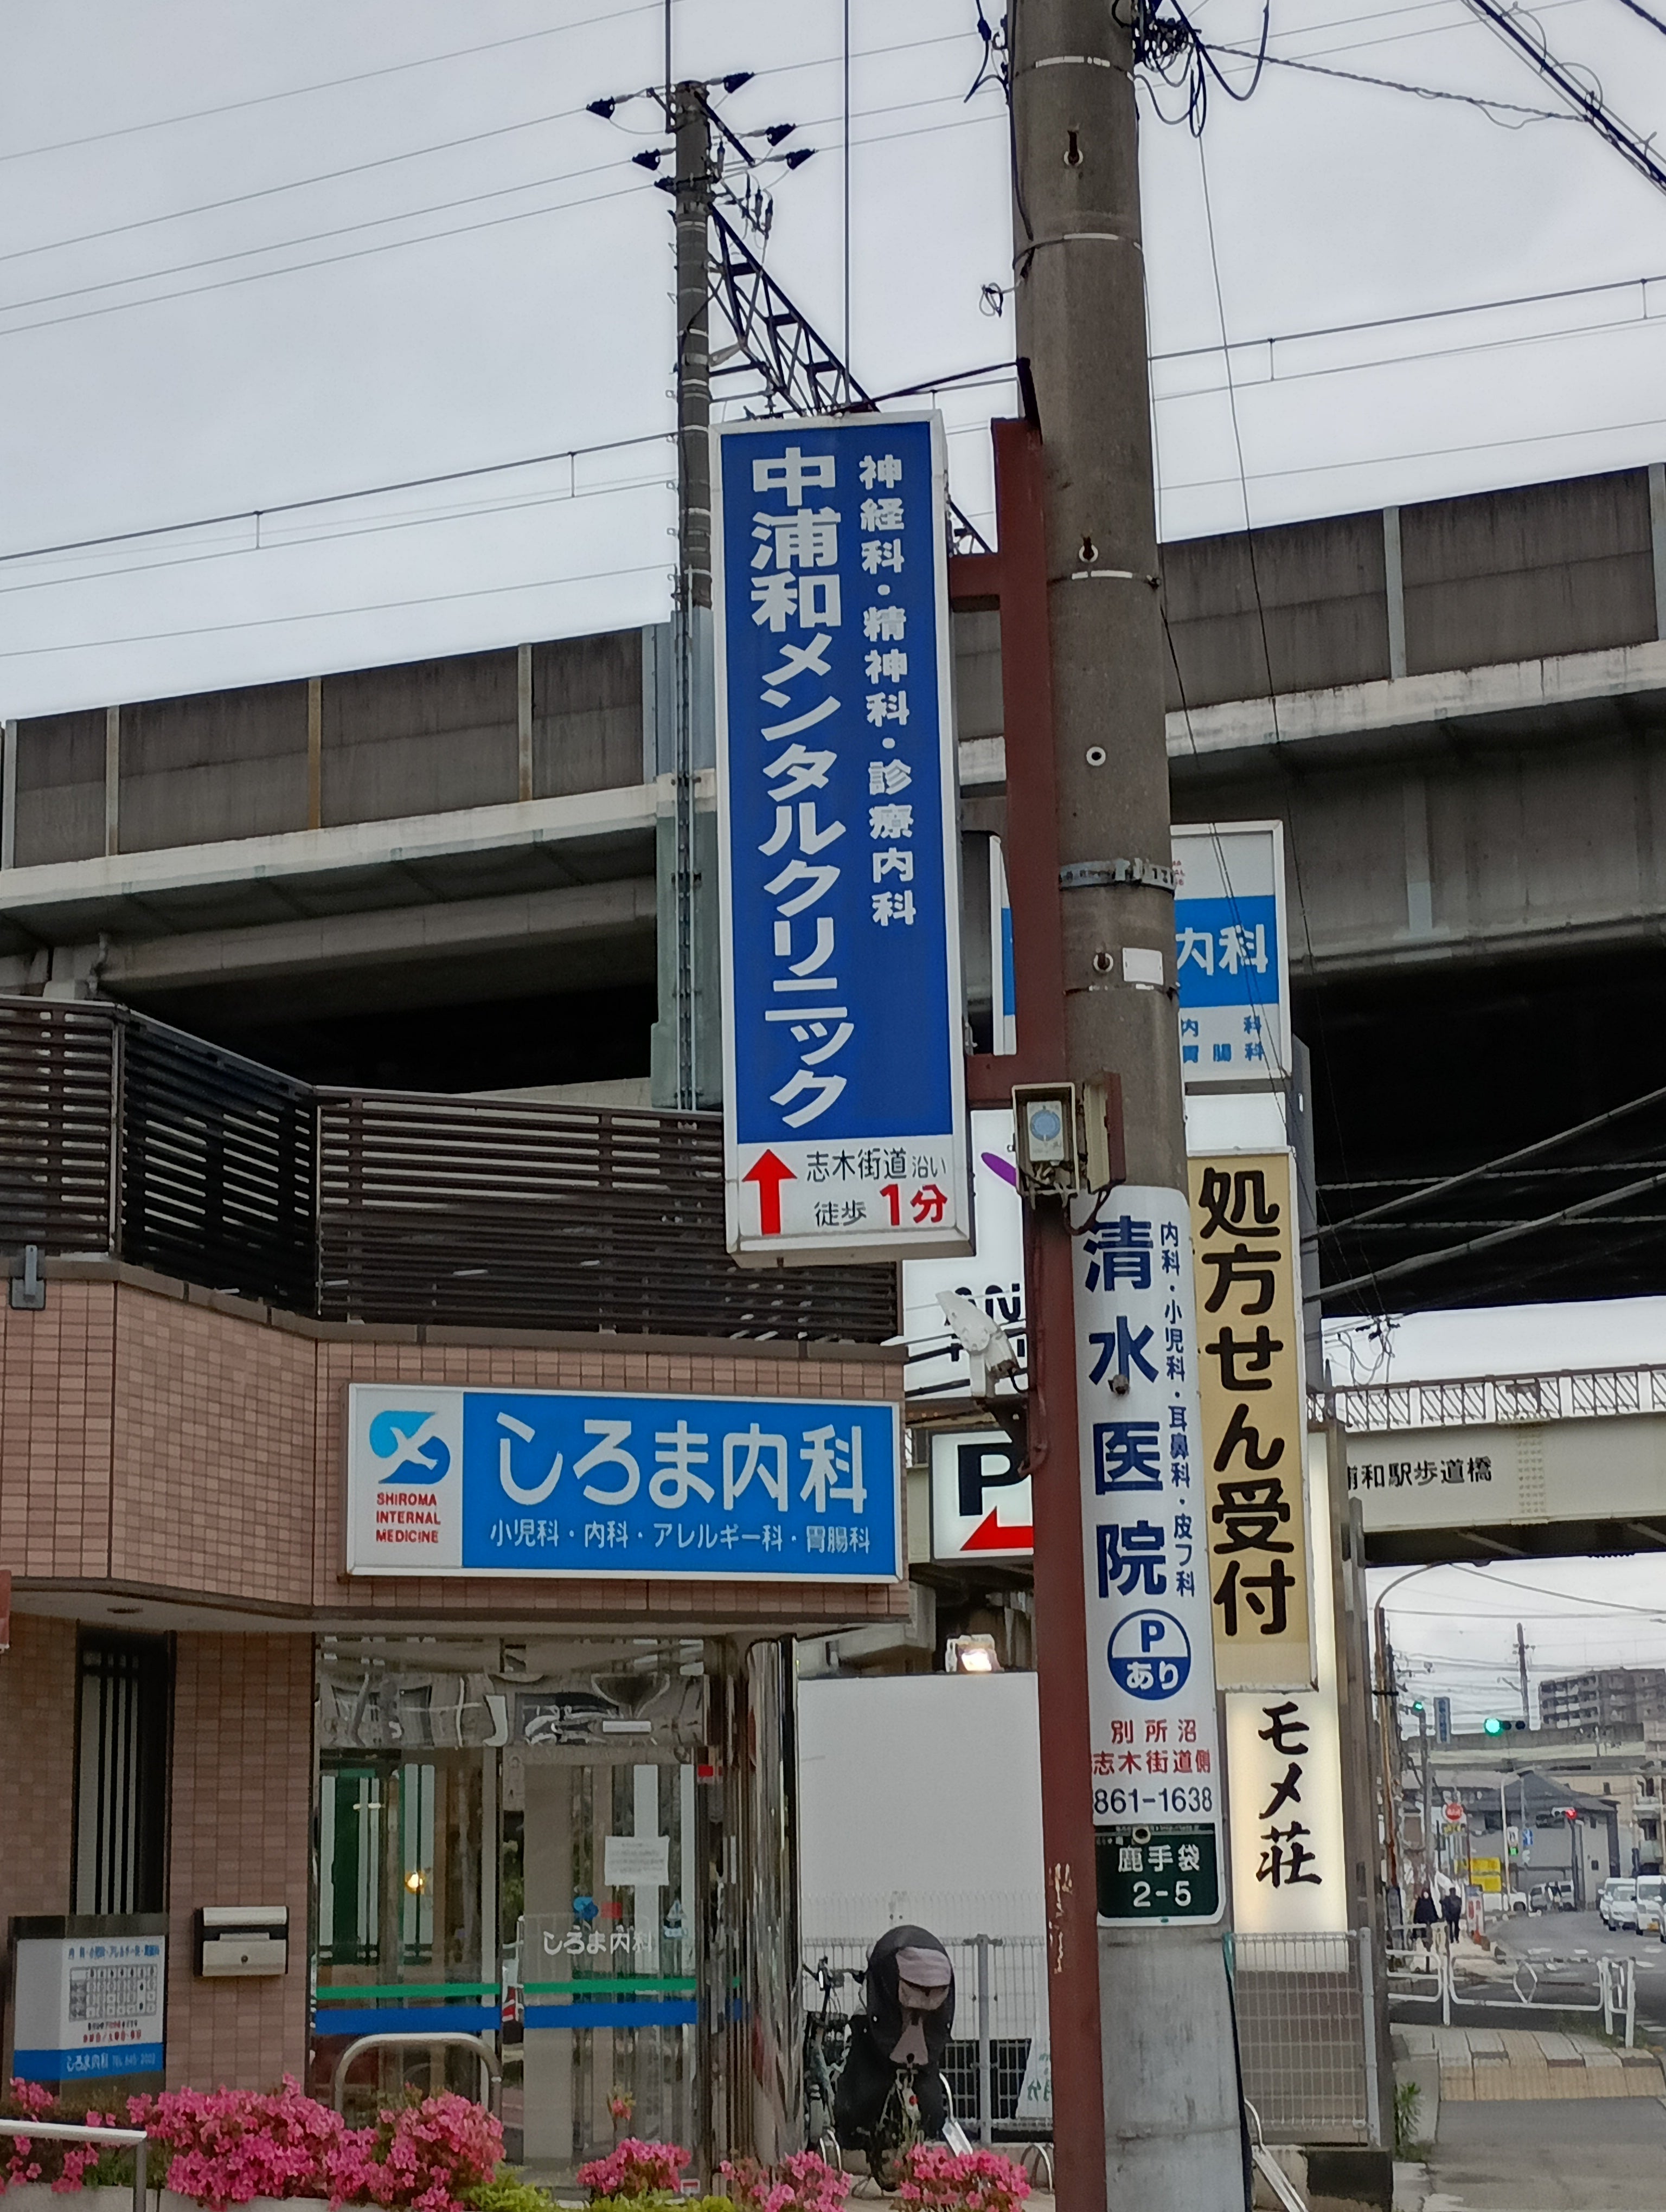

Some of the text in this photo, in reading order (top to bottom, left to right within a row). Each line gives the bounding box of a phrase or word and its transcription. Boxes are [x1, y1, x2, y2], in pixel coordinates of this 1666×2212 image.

[859, 454, 916, 927] 神経科・精神科・診療内科
[751, 447, 854, 1129] 中浦和メンタルクリニック
[806, 1147, 947, 1182] 志木街道沿い
[1085, 1214, 1167, 1599] 清水医院
[1199, 1167, 1295, 1636] 処方せん受付
[496, 1411, 868, 1515] しろま内科
[377, 1492, 437, 1506] SHIROMA
[376, 1510, 441, 1525] INTERNAL
[376, 1529, 438, 1543] MEDICINE
[1139, 1619, 1165, 1652] P
[1126, 1661, 1180, 1690] あり
[1111, 1719, 1197, 1744] 別所沼
[1093, 1749, 1210, 1776] 志木街道側
[1094, 1786, 1213, 1815] 861-1638
[1118, 1844, 1200, 1872] 鹿手袋
[1133, 1881, 1191, 1907] 2-5
